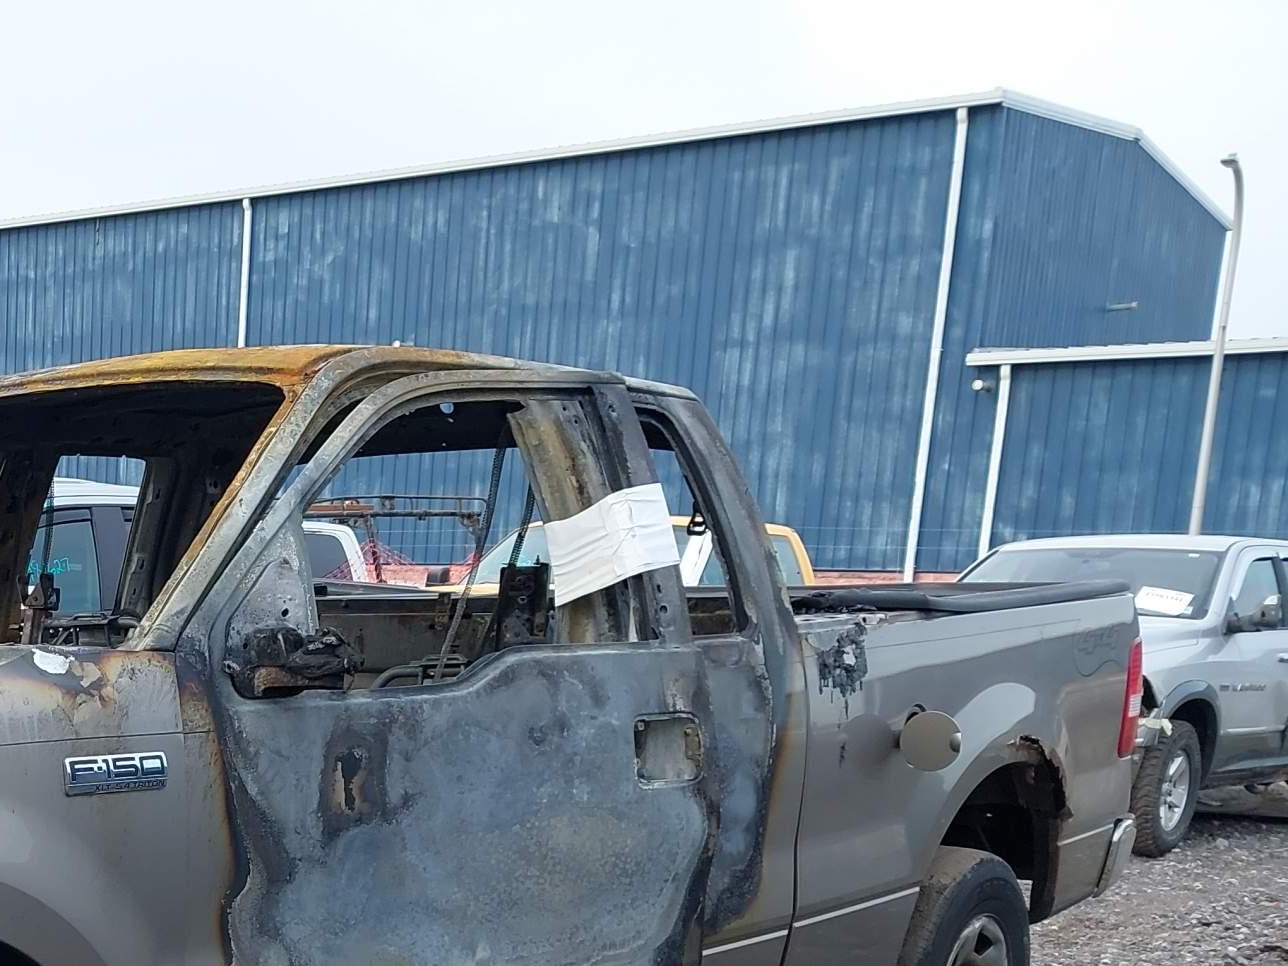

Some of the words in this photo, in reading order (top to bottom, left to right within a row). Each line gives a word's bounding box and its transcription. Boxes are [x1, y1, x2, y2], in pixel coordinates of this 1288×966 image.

[68, 754, 166, 782] F-150
[94, 783, 111, 792] XLT
[135, 779, 167, 790] TRITON
